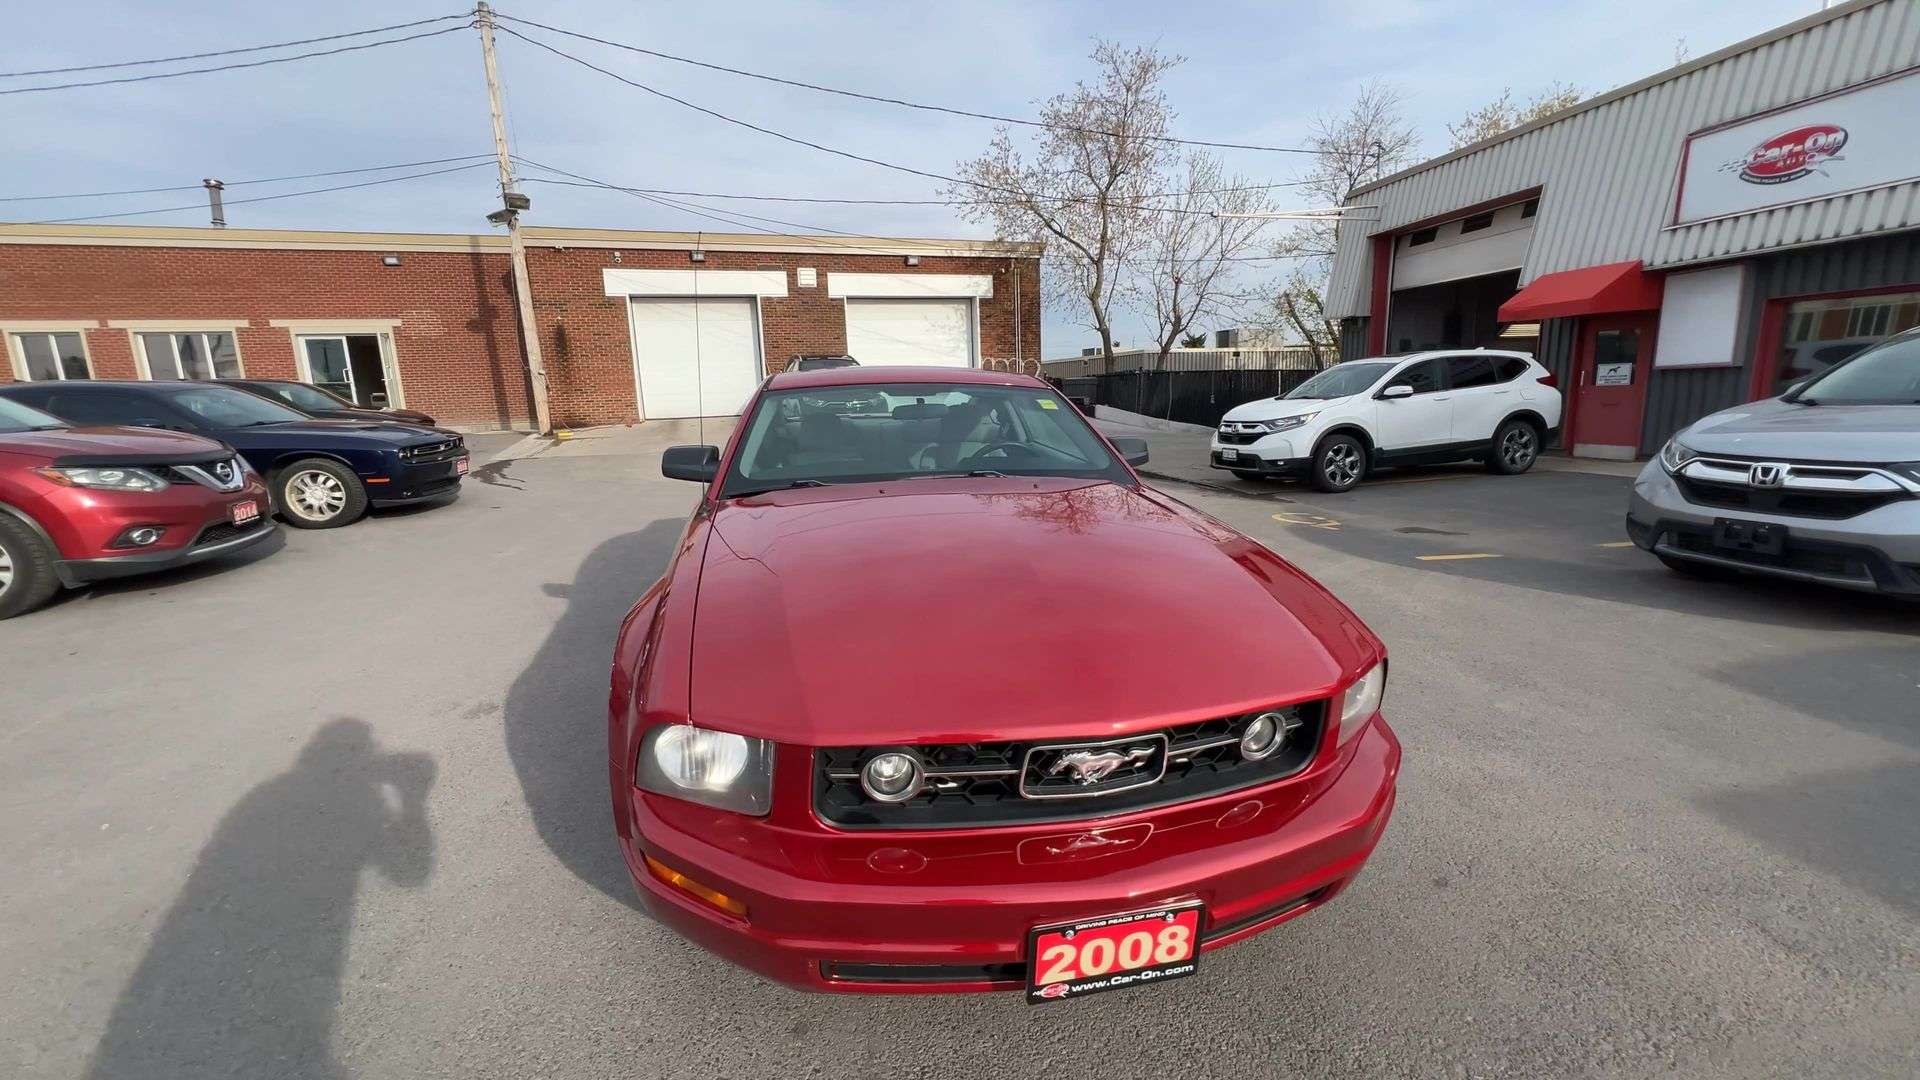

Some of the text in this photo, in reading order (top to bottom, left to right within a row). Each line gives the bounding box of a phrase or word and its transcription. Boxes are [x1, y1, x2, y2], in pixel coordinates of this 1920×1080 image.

[235, 503, 258, 520] 2014
[1075, 921, 1107, 930] DRIVING
[1108, 916, 1133, 925] PEACE
[1146, 911, 1166, 919] MIND
[1040, 925, 1190, 985] 2008
[1071, 965, 1193, 993] www.Car-On.com
